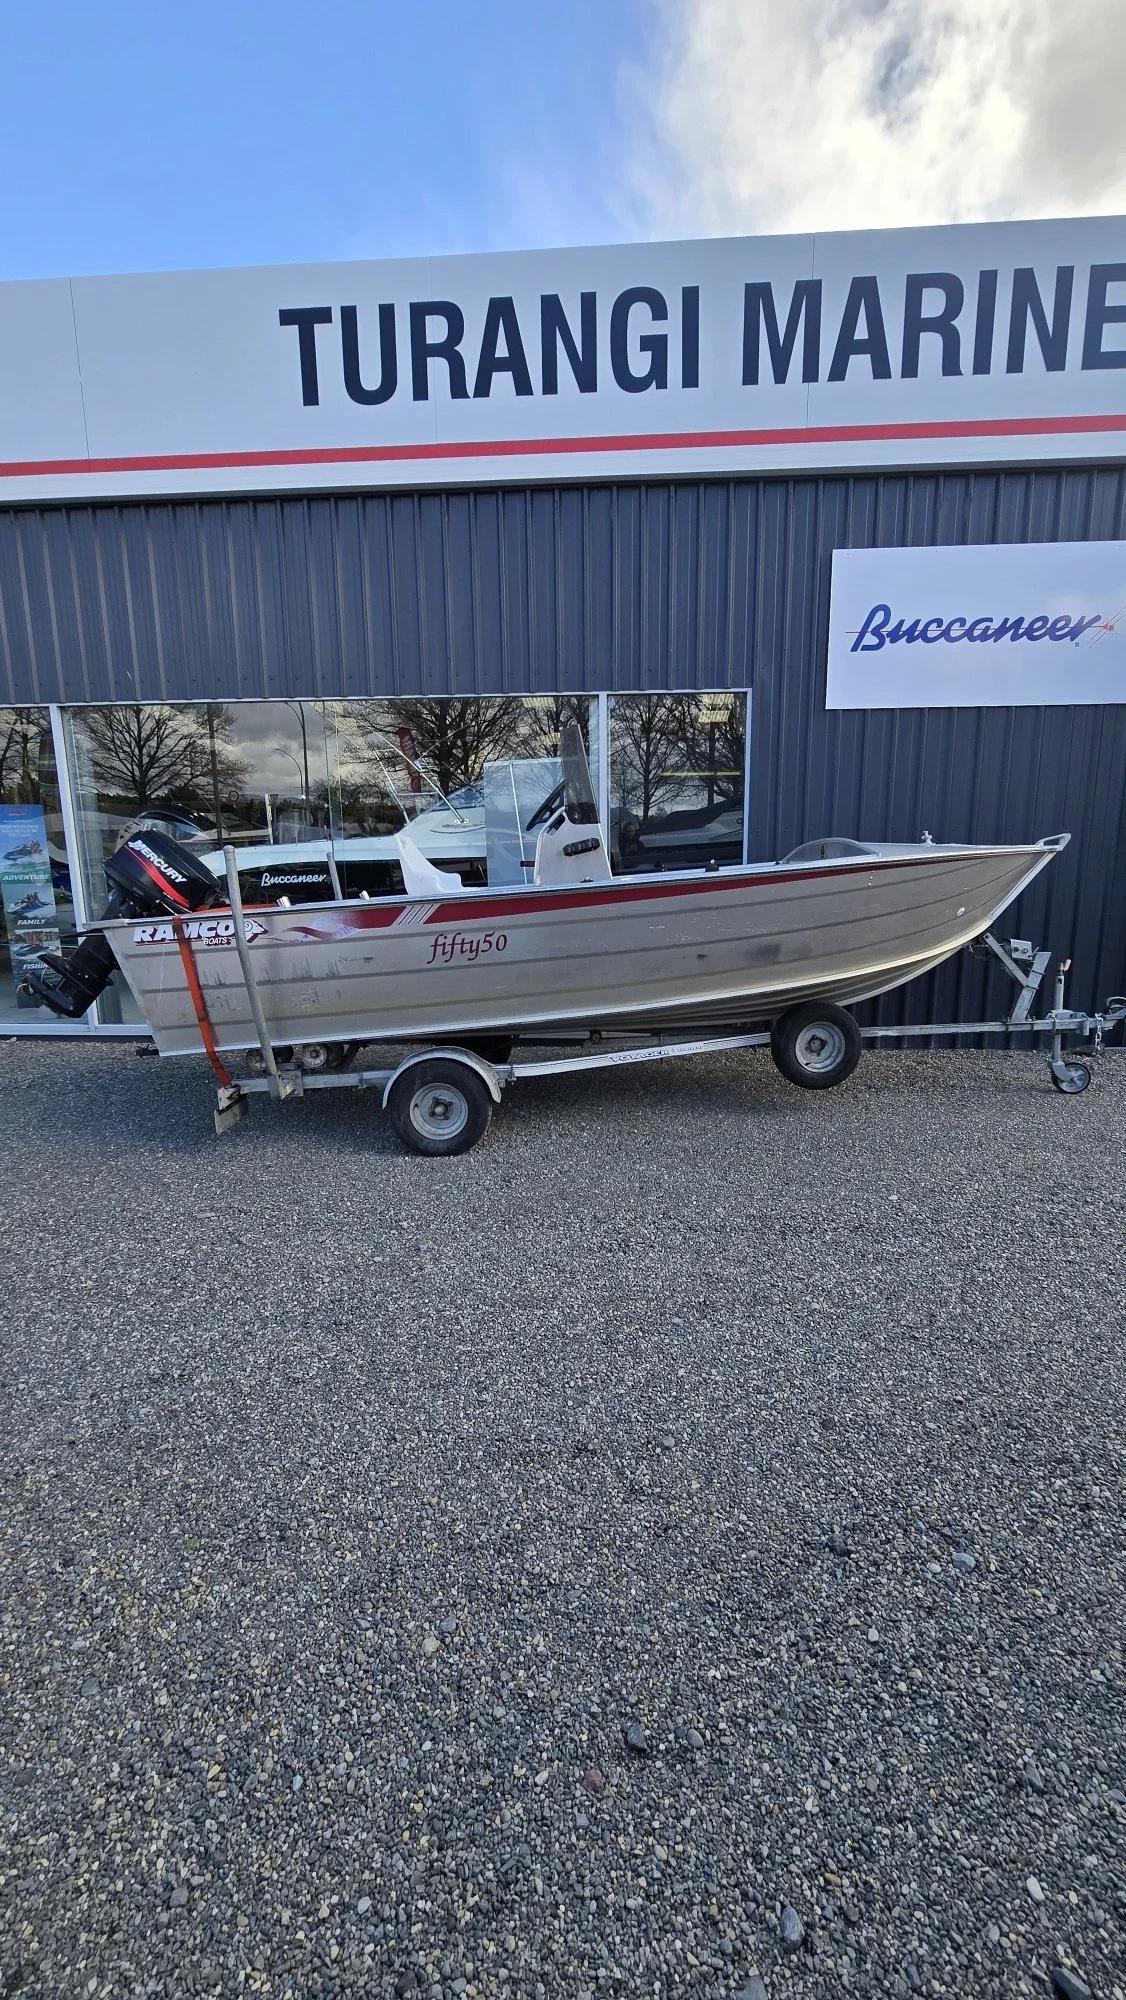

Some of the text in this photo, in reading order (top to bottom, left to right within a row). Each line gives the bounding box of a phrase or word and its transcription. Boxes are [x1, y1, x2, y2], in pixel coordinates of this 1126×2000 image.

[278, 262, 1126, 406] TURANGI MARINE
[850, 603, 1102, 652] Buccaneer
[128, 840, 188, 882] MERCURY
[261, 872, 327, 886] Buccaneer
[133, 919, 235, 944] RAMCO
[203, 936, 228, 946] BOATS
[426, 931, 508, 964] fifty50
